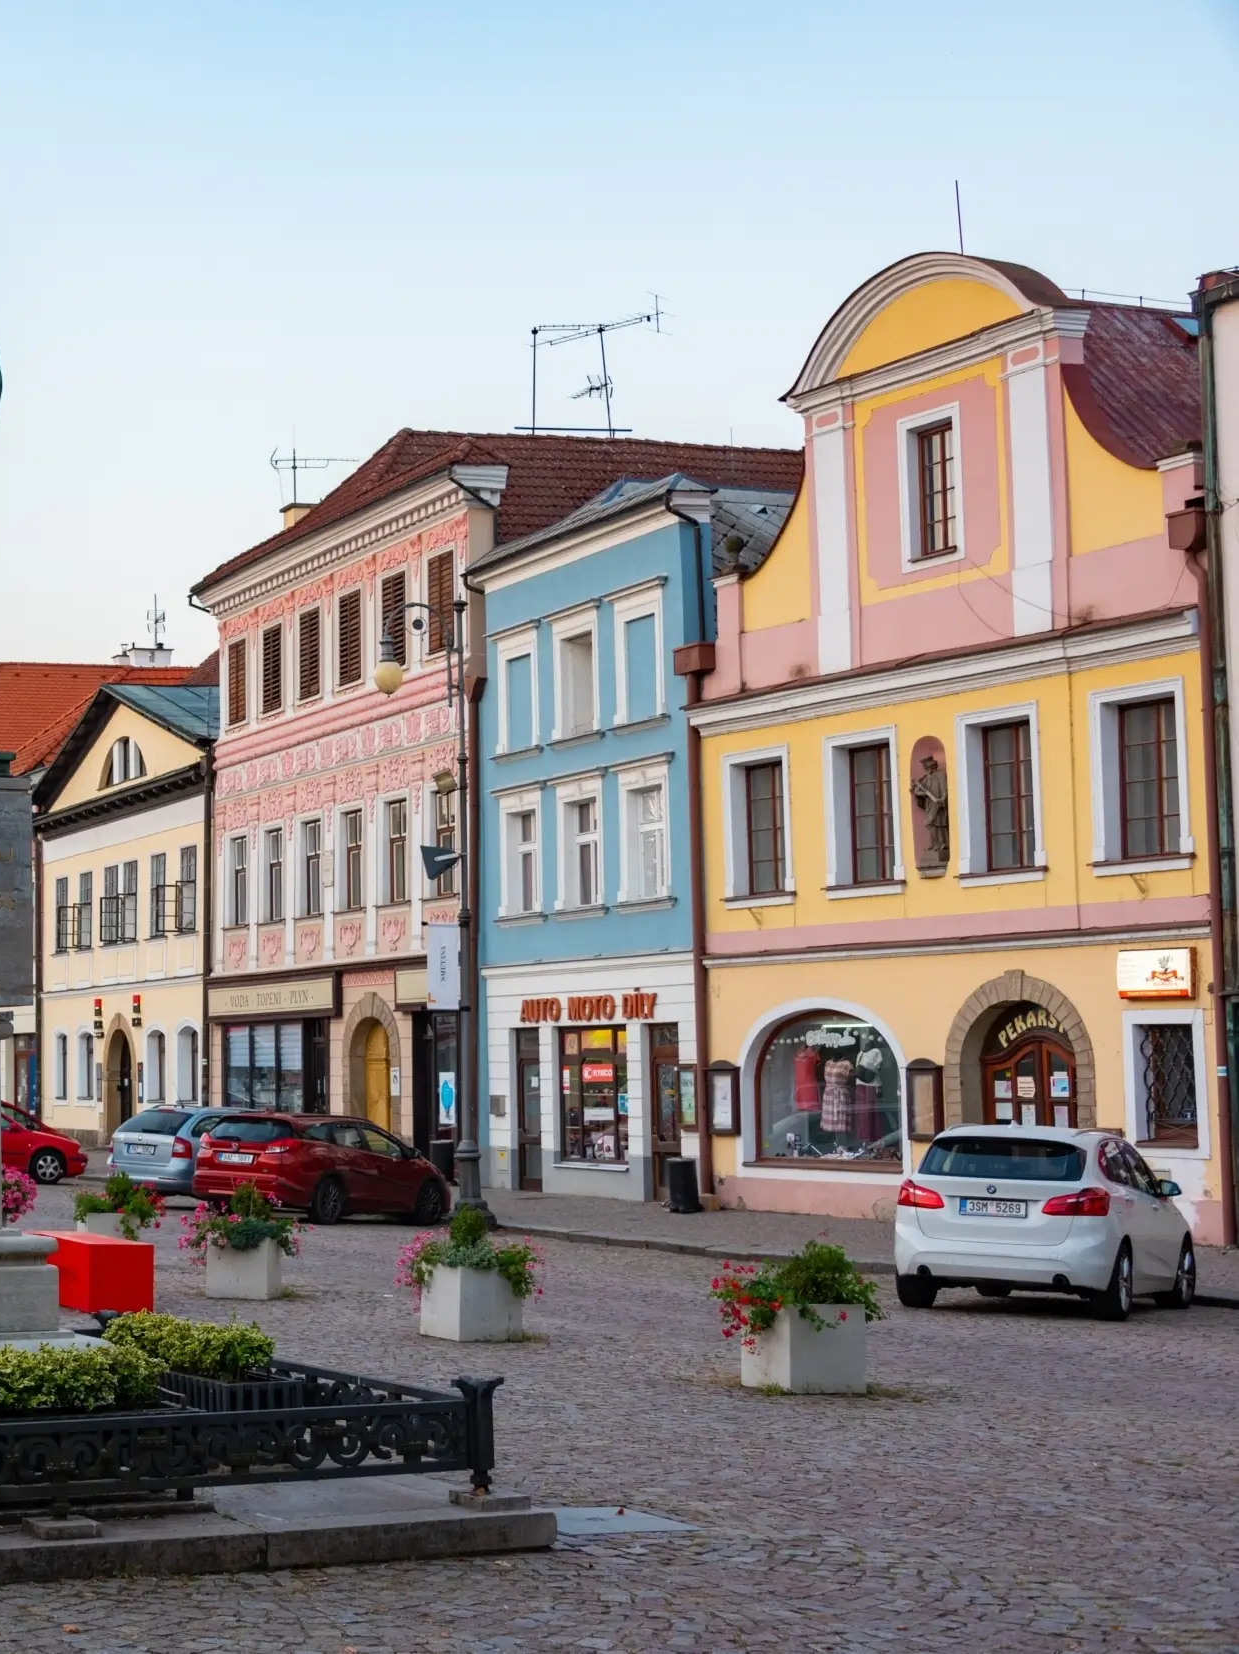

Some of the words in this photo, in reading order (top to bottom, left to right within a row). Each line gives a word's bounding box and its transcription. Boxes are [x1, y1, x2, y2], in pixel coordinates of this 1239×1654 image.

[230, 994, 250, 1008] VODA
[289, 989, 309, 1004] PLYN
[520, 997, 562, 1023] AUTO
[567, 994, 616, 1021] MOTO
[622, 987, 657, 1020] DÍLY
[968, 1200, 989, 1213] 3SM
[995, 1202, 1021, 1214] 5269
